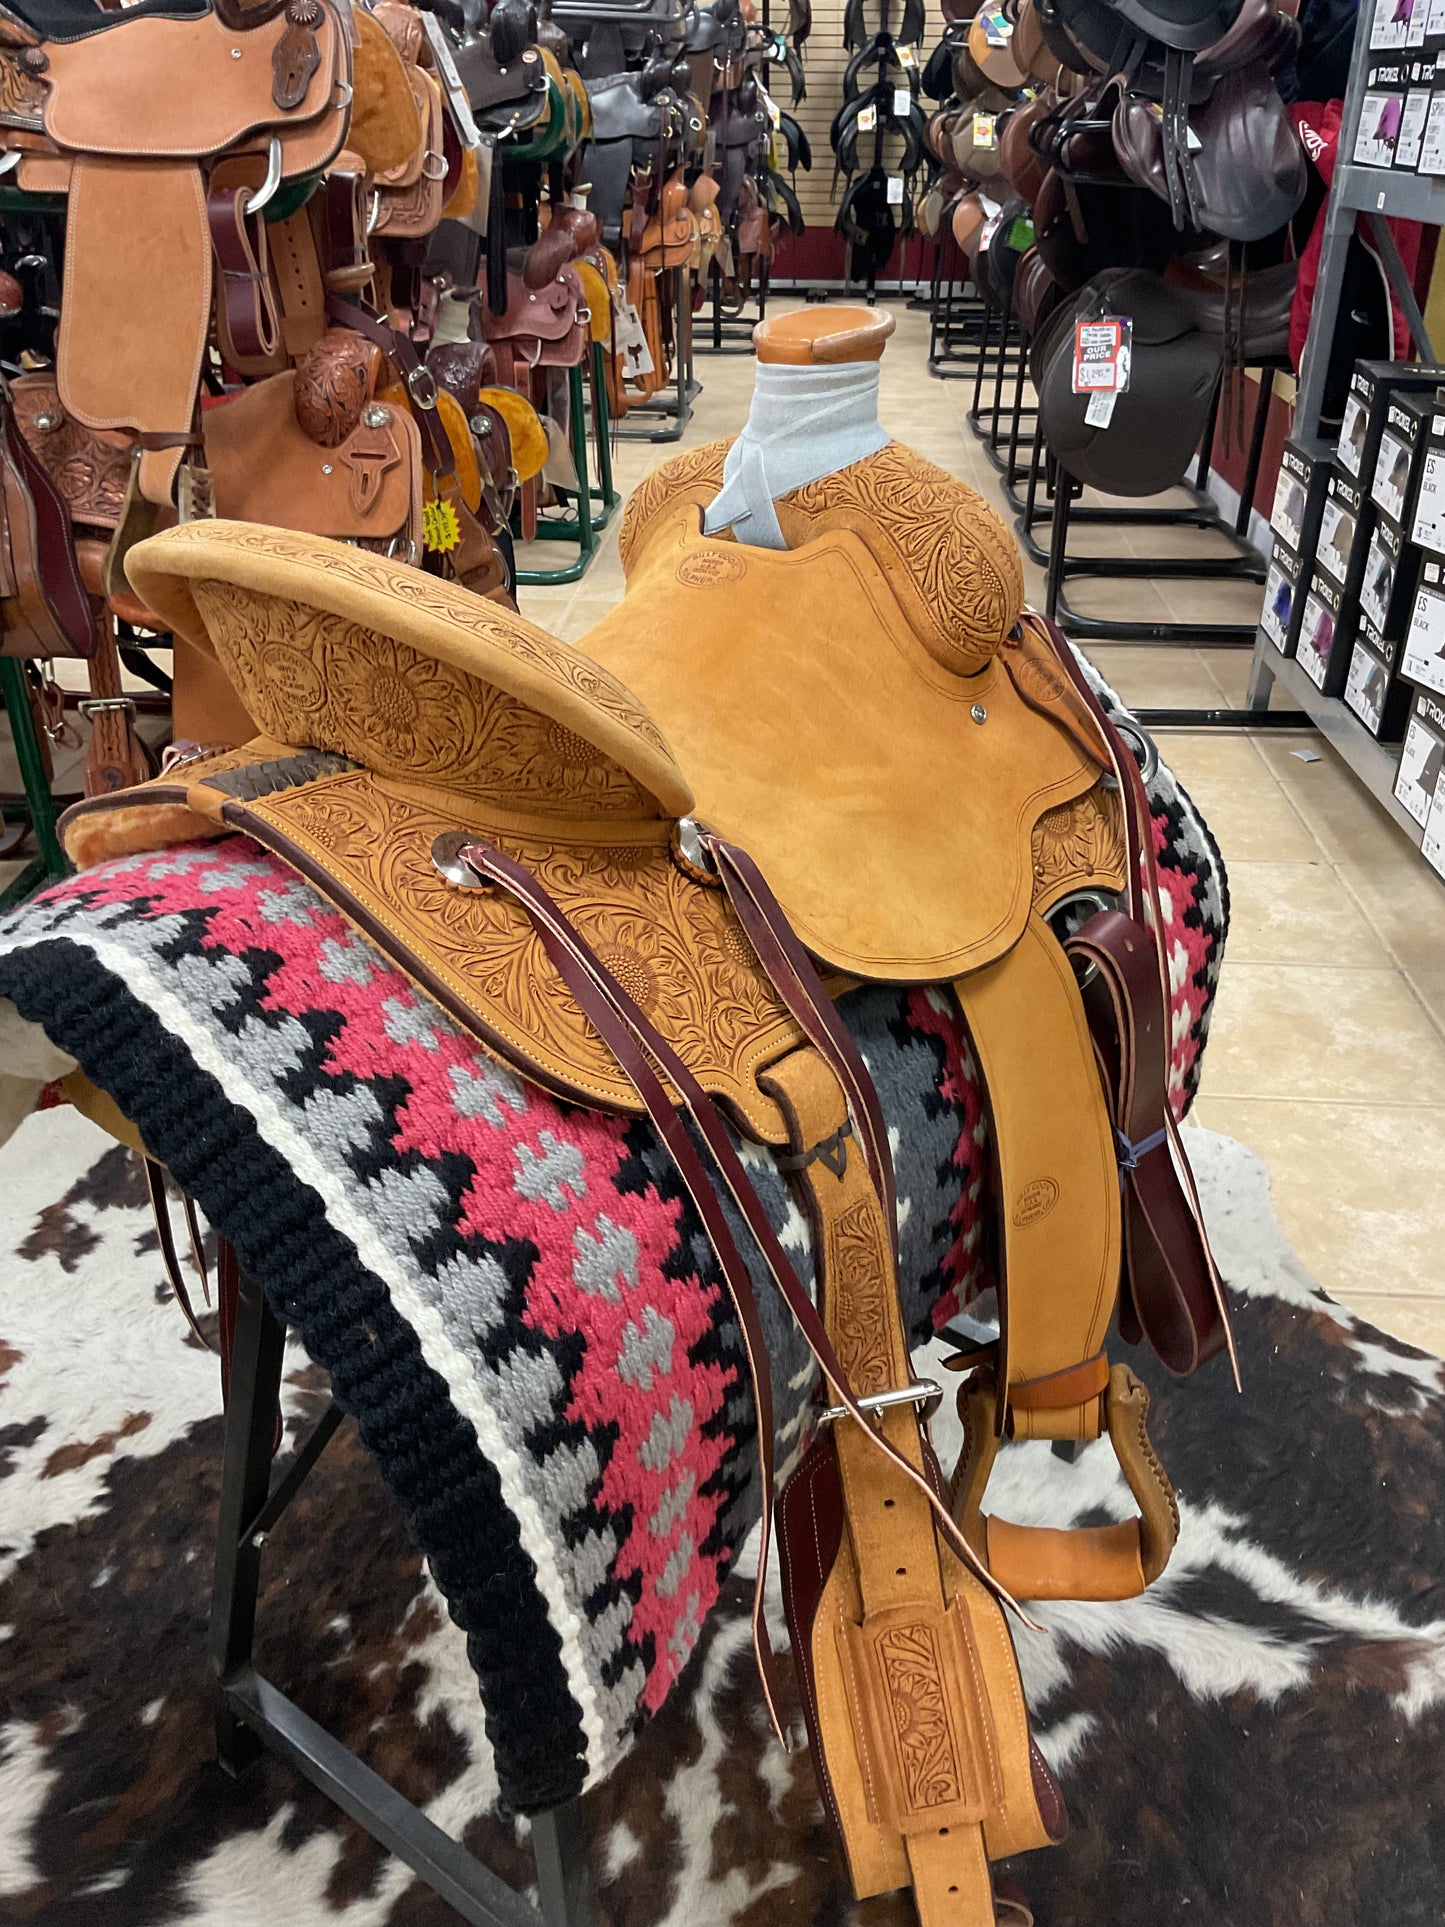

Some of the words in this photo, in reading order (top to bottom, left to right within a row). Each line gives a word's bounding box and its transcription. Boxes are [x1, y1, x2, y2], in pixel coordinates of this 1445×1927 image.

[1083, 351, 1111, 361] PRICE
[1087, 346, 1107, 354] OUR
[1422, 480, 1437, 494] BLACK
[1413, 616, 1430, 632] BLACK
